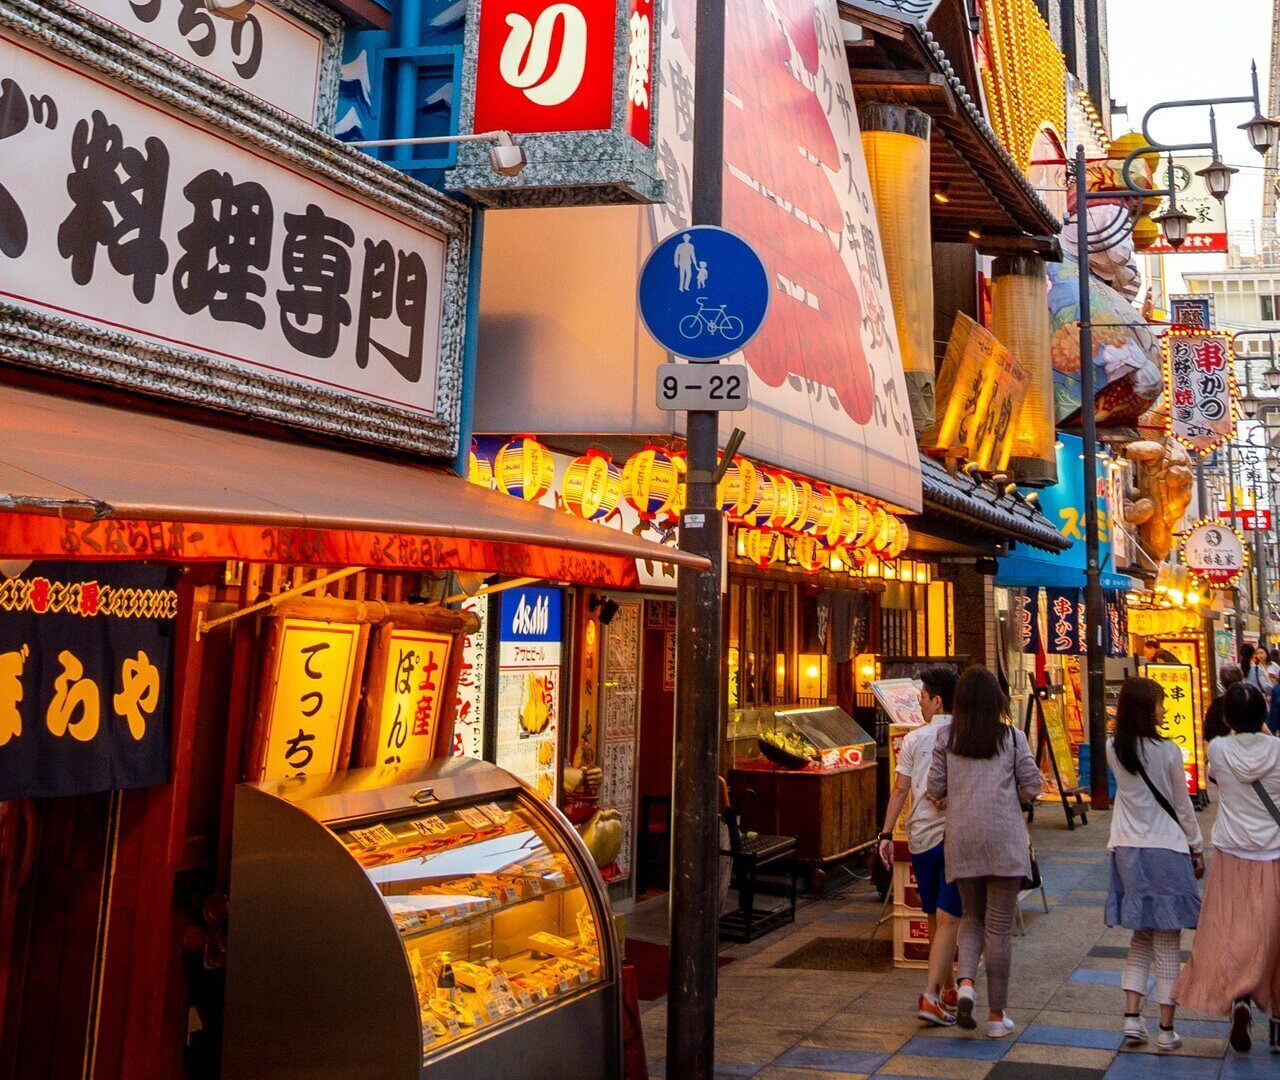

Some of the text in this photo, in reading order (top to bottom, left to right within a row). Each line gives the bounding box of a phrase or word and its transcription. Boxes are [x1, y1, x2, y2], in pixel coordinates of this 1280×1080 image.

[1173, 342, 1196, 421] お好み焼き
[1193, 341, 1226, 420] 串かつ
[512, 593, 550, 635] Asahi
[1053, 596, 1073, 651] 串かつ
[284, 642, 331, 779] てっち
[411, 650, 439, 737] 土産
[1170, 685, 1187, 744] 串かつ
